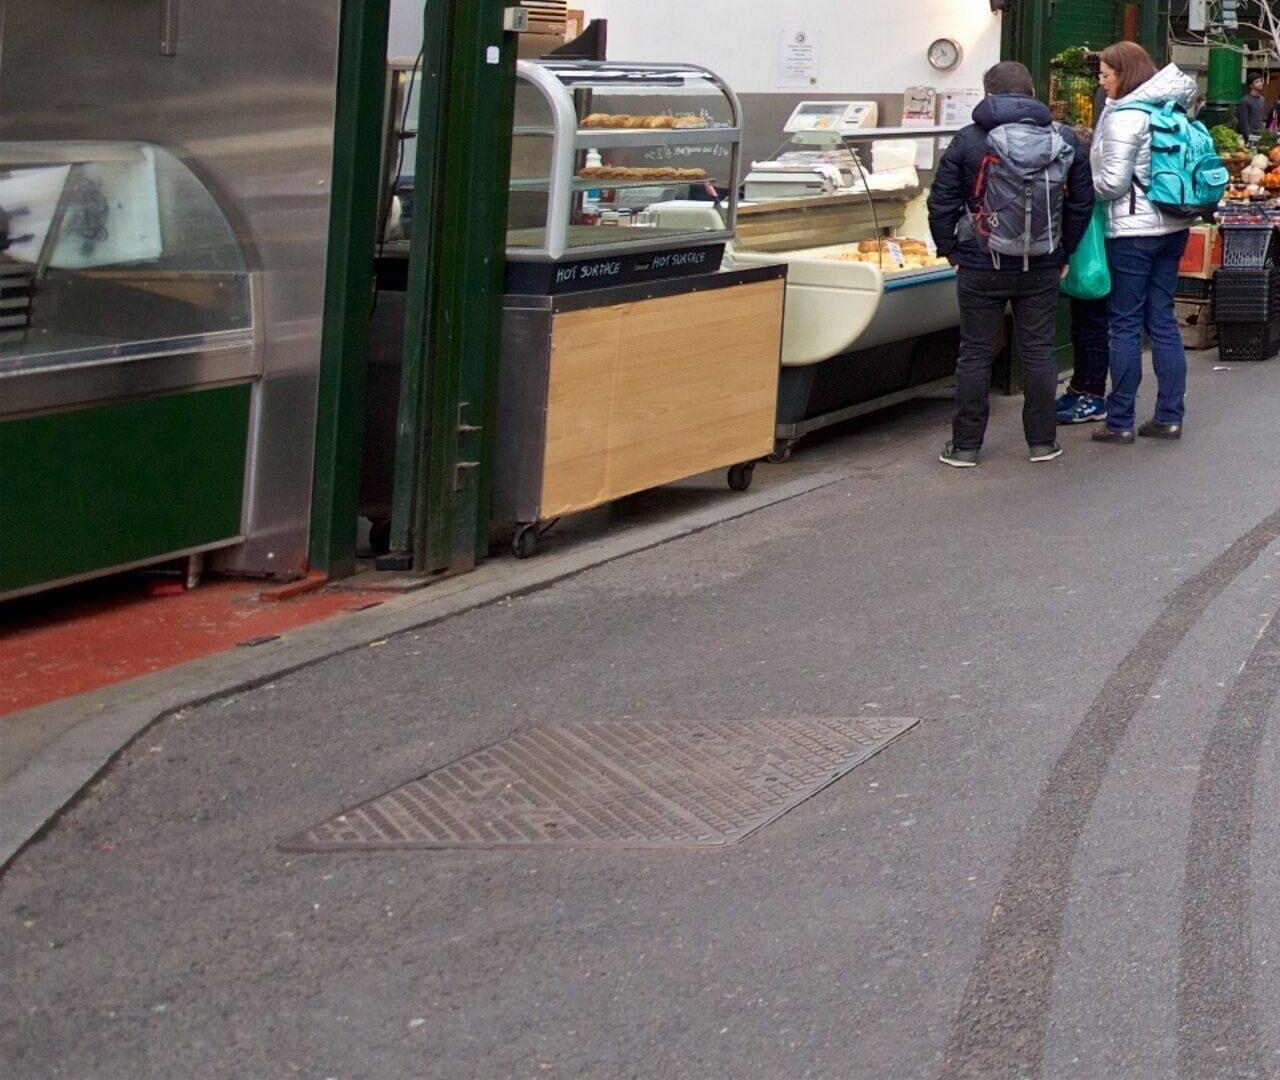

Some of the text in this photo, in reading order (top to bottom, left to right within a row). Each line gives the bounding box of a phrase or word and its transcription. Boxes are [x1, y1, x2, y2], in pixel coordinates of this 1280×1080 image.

[651, 254, 671, 270] HOT
[671, 251, 706, 266] SURFACE
[556, 268, 577, 283] HOT
[579, 261, 622, 279] SURFACE
